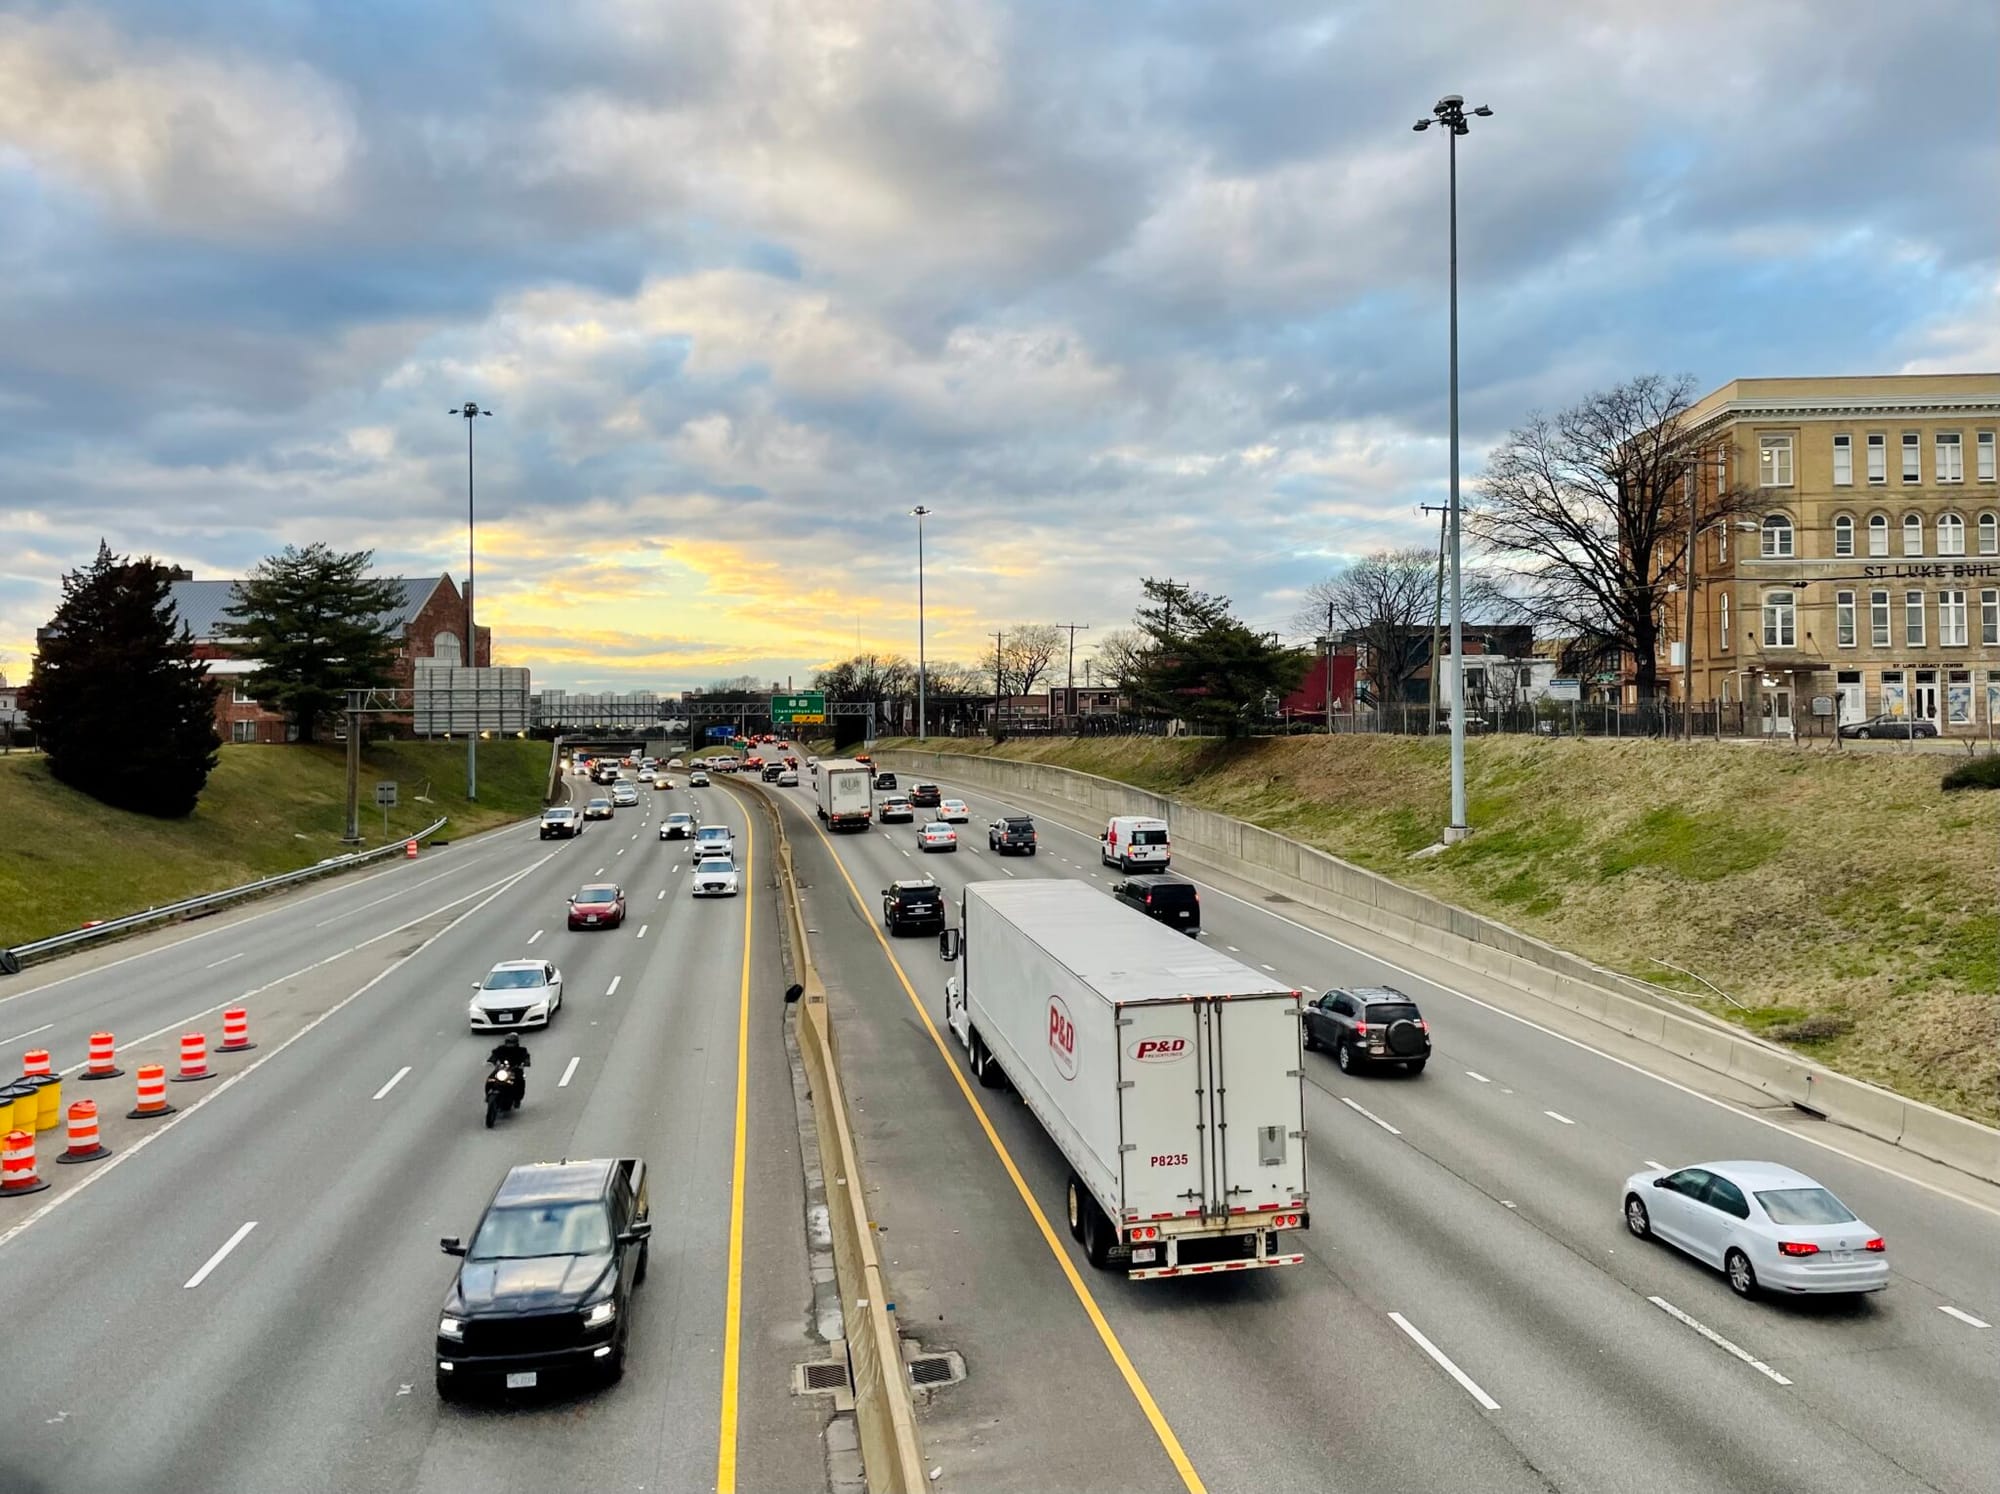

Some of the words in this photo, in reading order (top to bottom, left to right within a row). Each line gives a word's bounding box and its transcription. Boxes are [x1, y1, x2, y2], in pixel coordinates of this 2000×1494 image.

[1864, 566, 1887, 578] ST
[1896, 565, 1946, 578] LUKE
[1953, 565, 1998, 577] BUIL
[1049, 1004, 1074, 1054] P&D
[1136, 1039, 1185, 1059] P&D
[1151, 1153, 1189, 1168] P8235
